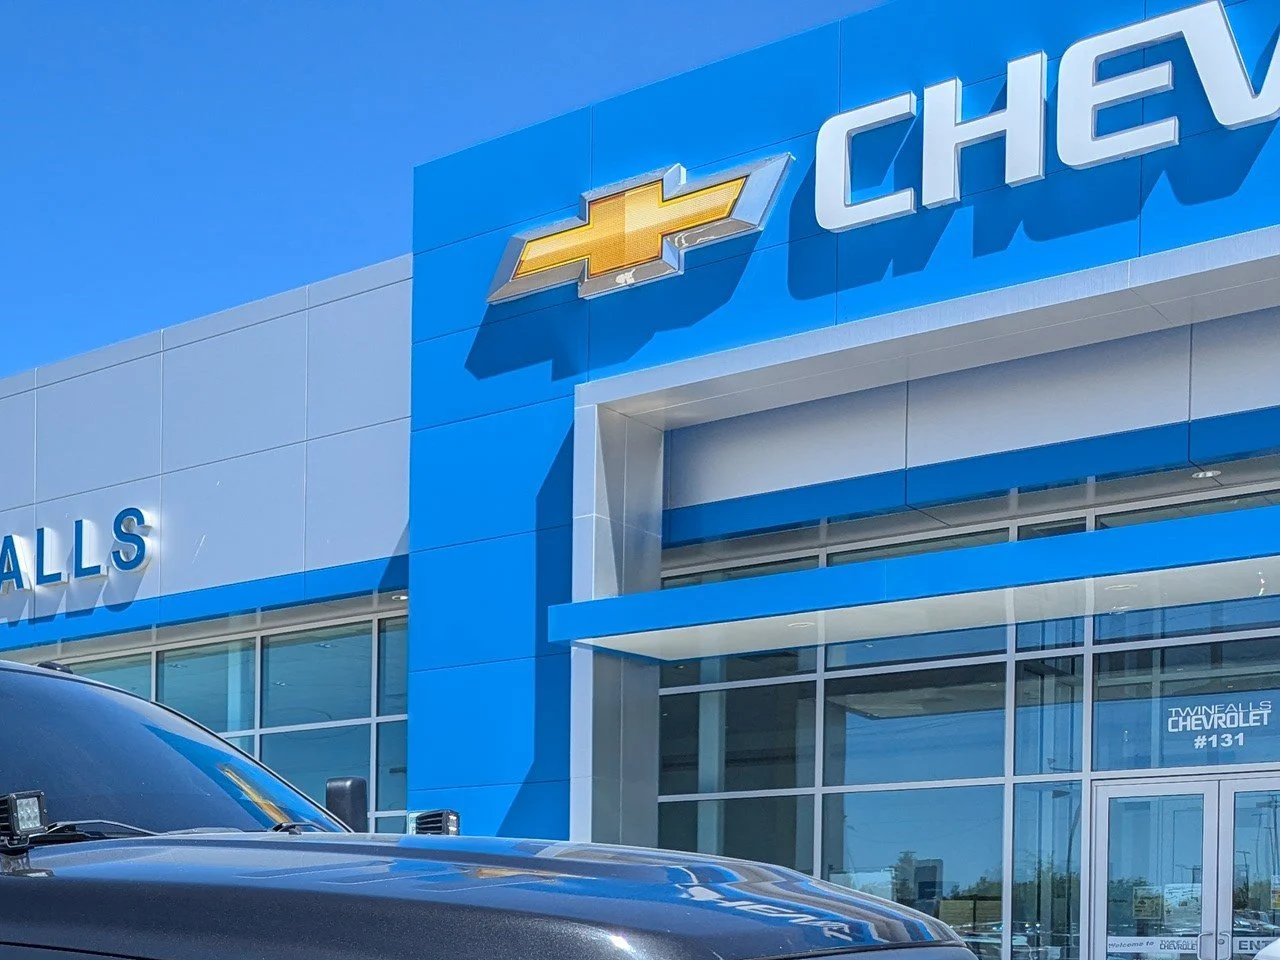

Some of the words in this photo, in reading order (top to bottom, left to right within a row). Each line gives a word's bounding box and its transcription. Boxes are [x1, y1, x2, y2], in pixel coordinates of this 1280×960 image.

[1168, 700, 1272, 717] TWINFALLS
[1167, 710, 1272, 733] CHEVROLET
[1193, 732, 1244, 749] #131
[1160, 943, 1198, 951] CHEVROLE
